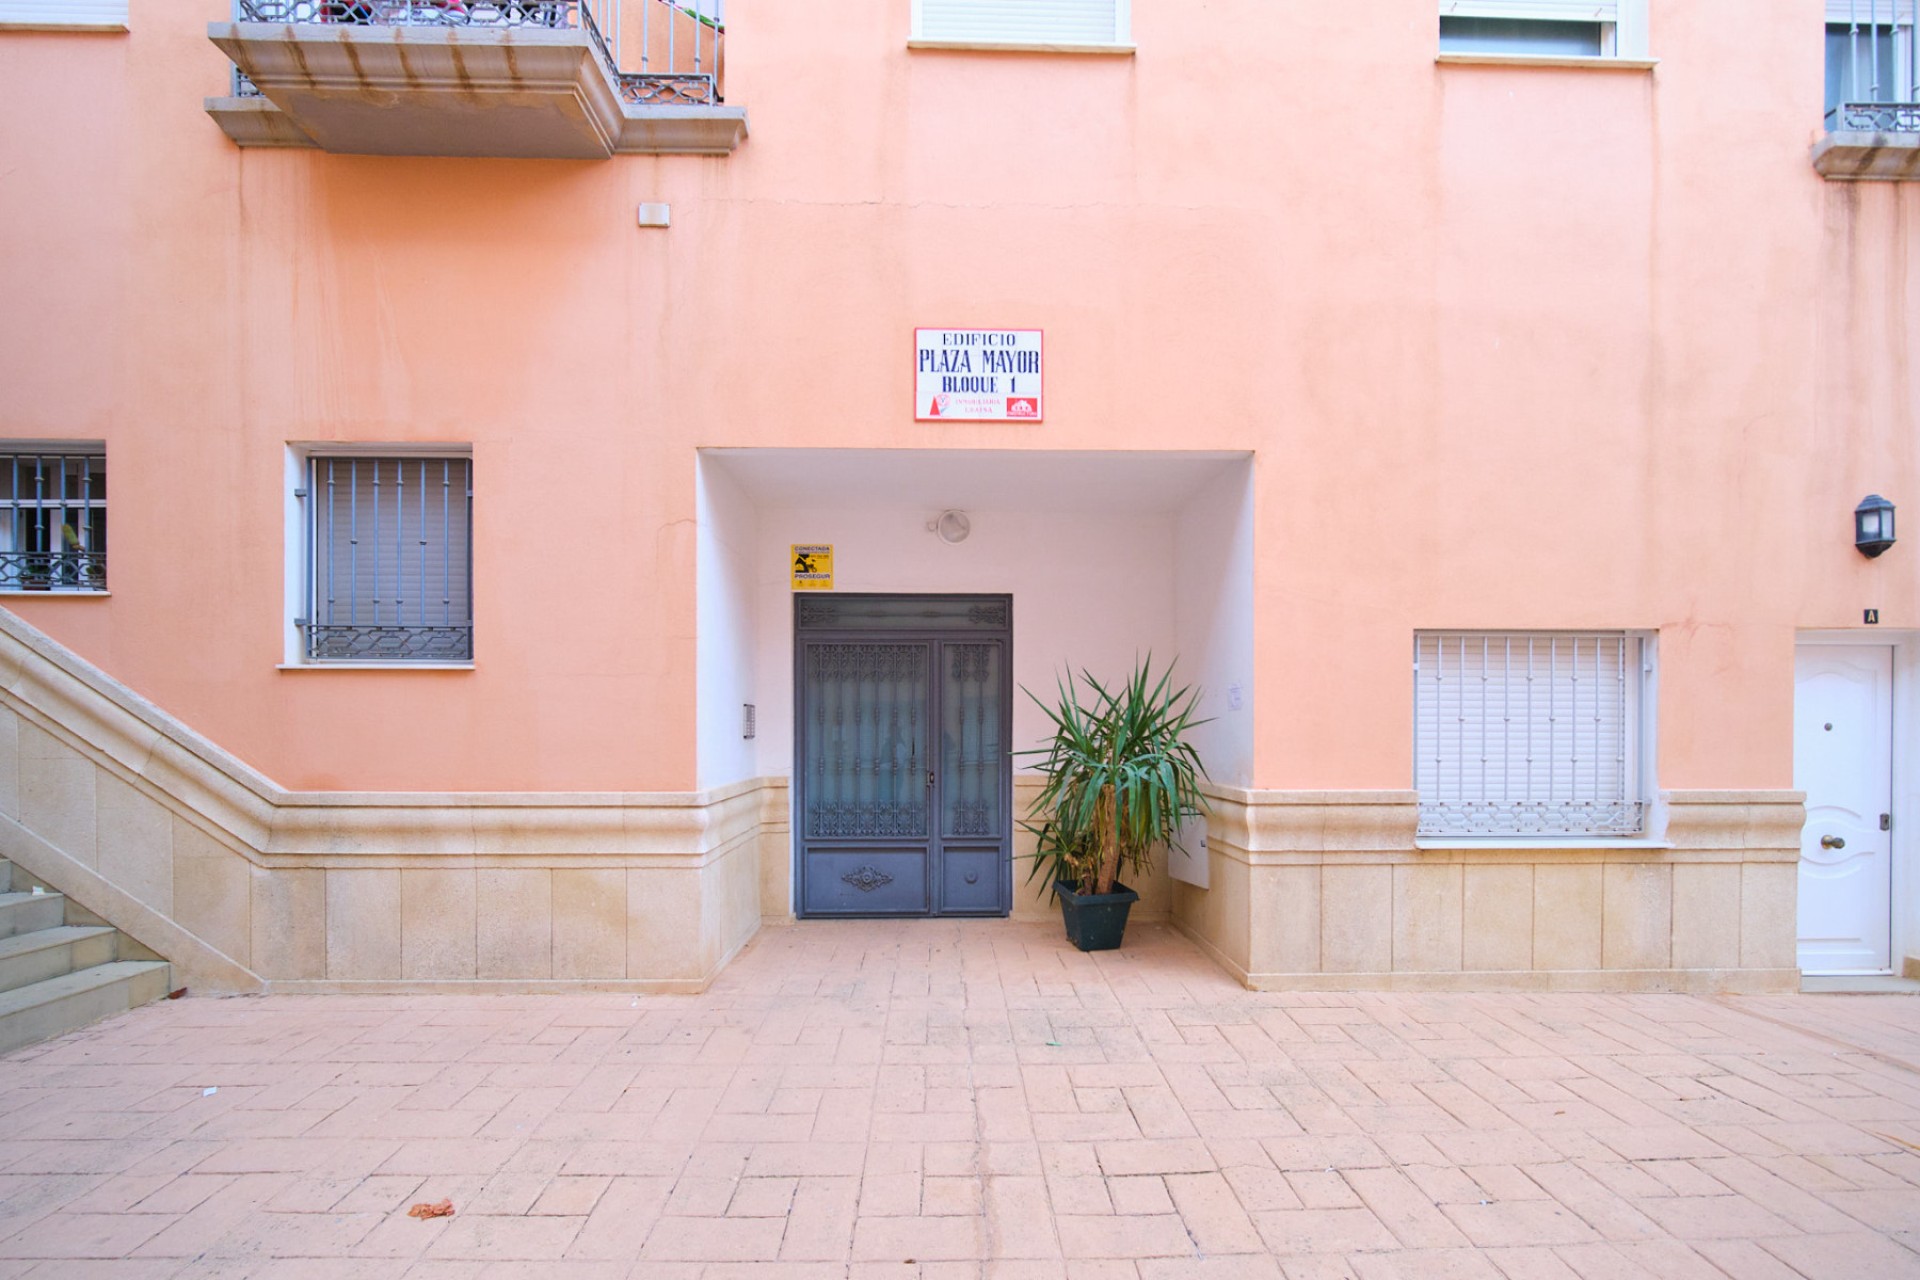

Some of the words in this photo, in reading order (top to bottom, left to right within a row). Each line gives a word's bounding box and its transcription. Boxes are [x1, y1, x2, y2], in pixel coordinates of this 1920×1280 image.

[943, 333, 1016, 346] EDIFICIO
[919, 349, 972, 373] PLAZA
[982, 349, 1039, 373] MAYOR
[942, 376, 998, 393] BLOQUE
[1010, 376, 1016, 393] 1
[1867, 610, 1876, 622] A
